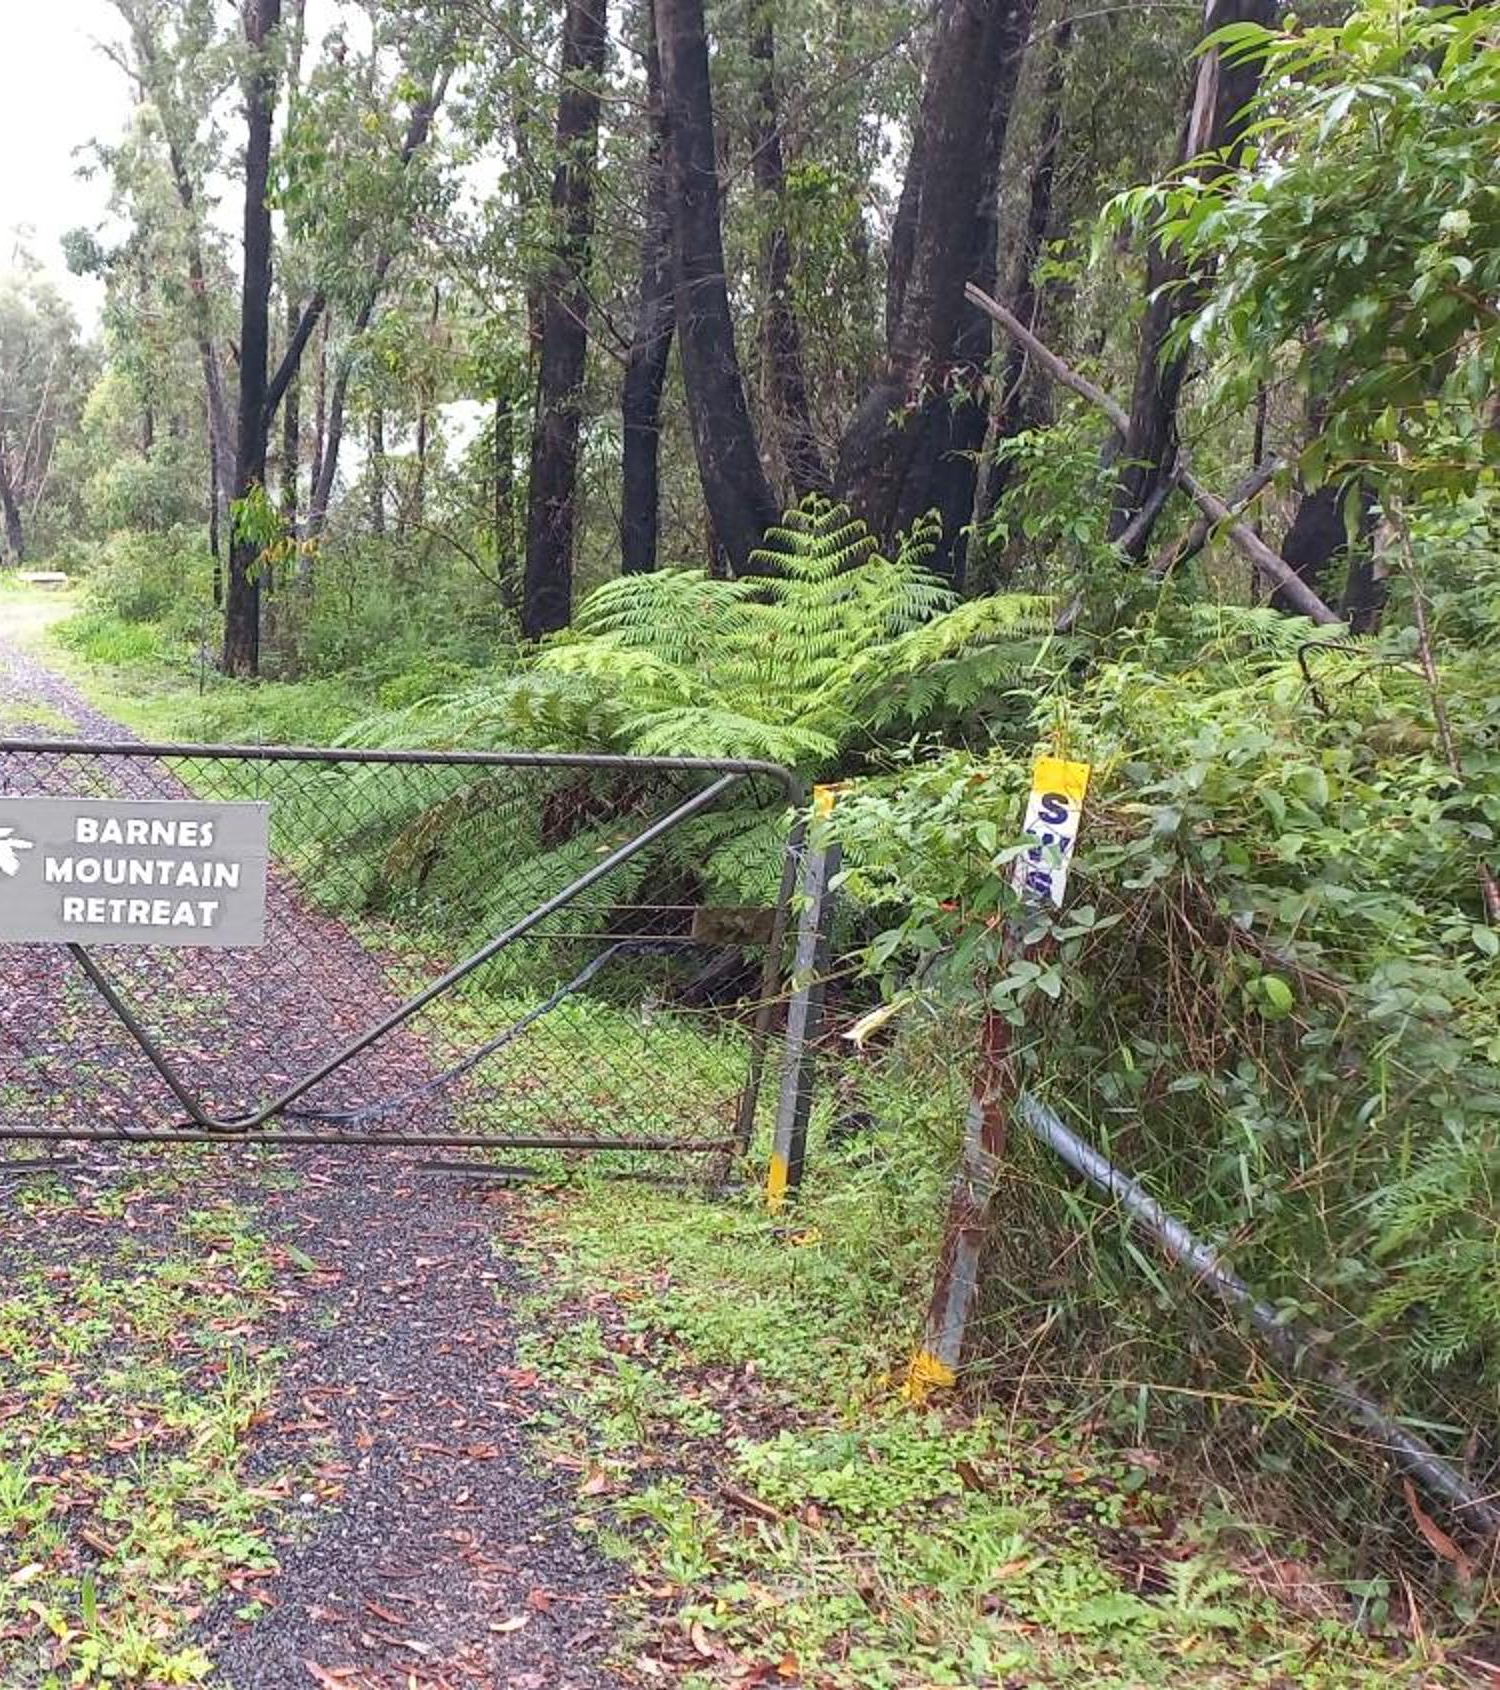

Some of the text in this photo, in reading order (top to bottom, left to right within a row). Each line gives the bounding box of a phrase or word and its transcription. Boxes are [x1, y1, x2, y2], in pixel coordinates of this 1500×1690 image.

[76, 817, 214, 848] BARNES
[44, 857, 241, 888] MOUNTAIN
[62, 897, 219, 927] RETREAT
